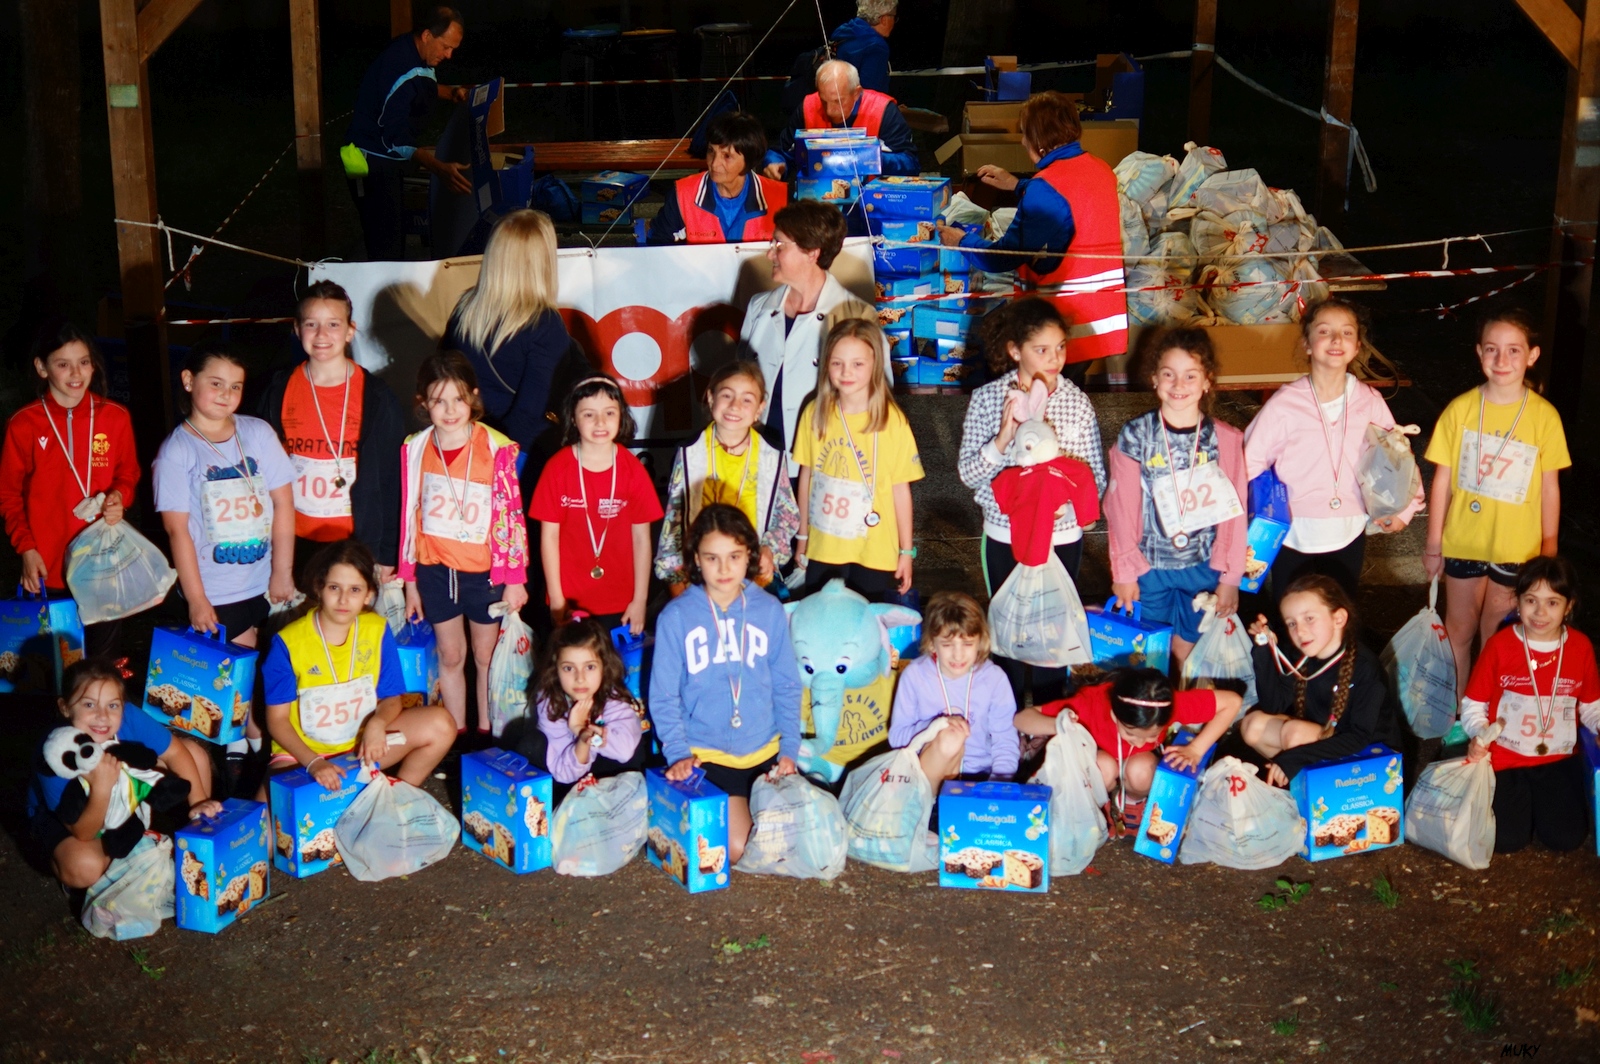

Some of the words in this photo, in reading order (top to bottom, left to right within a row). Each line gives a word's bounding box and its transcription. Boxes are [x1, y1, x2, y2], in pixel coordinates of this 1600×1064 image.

[1479, 453, 1514, 481] 57
[297, 474, 344, 499] 102
[1180, 482, 1217, 512] 92
[428, 494, 480, 525] 270
[821, 493, 850, 519] 58
[171, 649, 209, 670] Melegatti
[684, 618, 769, 676] GAP
[172, 676, 201, 692] CLASSICA
[315, 696, 364, 729] 257
[1520, 714, 1556, 739] 52
[1335, 772, 1377, 788] Melegatti
[319, 784, 357, 803] Melegatti
[1341, 799, 1375, 811] CLASSICA
[968, 811, 1017, 827] Melegatti
[974, 839, 1013, 848] CLASSICA
